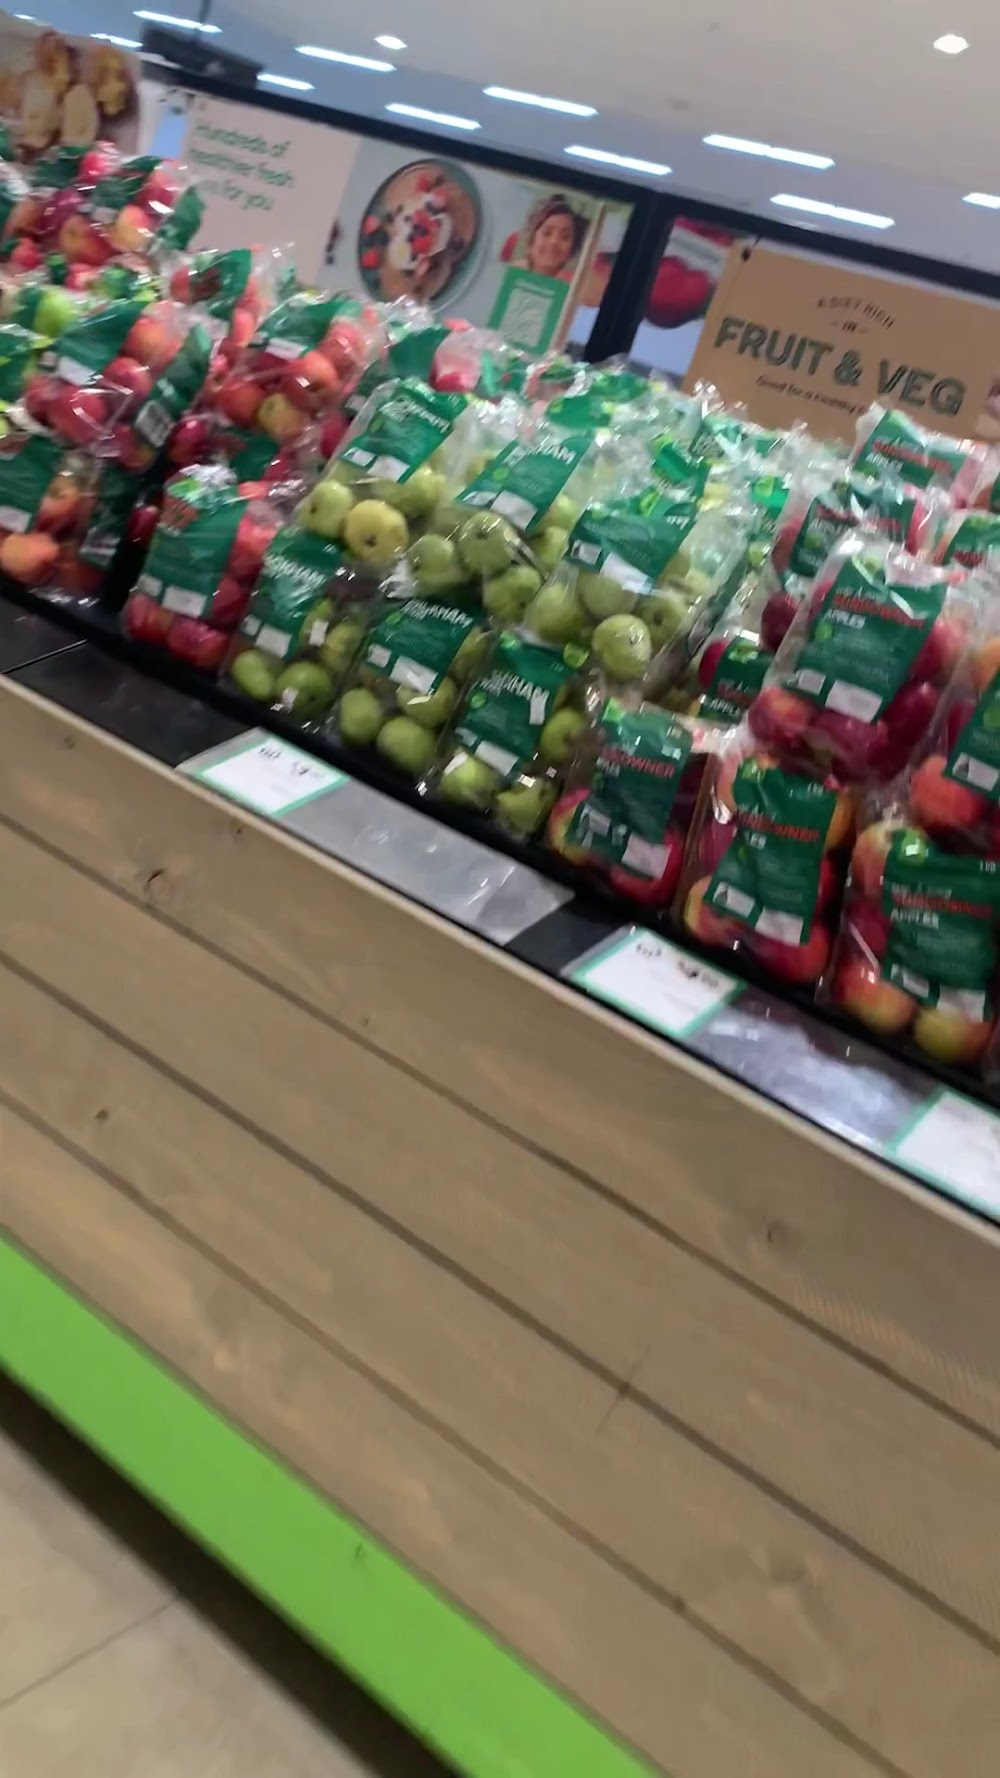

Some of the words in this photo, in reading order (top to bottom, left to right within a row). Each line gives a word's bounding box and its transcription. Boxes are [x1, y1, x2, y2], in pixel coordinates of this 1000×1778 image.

[713, 315, 836, 377] FRUIT
[833, 348, 865, 388] &
[876, 357, 968, 417] VEG
[709, 698, 741, 717] APPLE
[889, 907, 940, 931] APPLES
